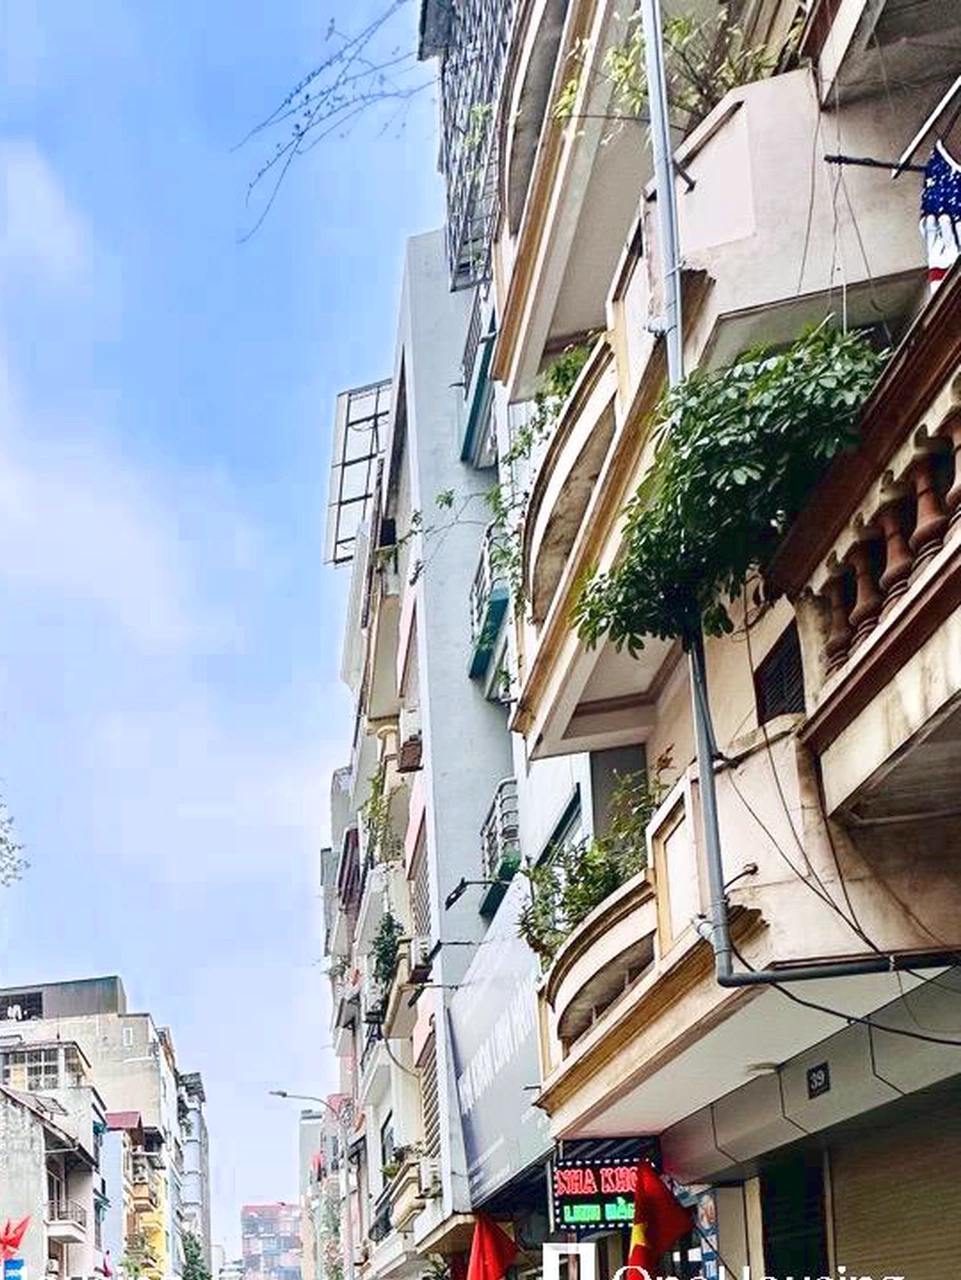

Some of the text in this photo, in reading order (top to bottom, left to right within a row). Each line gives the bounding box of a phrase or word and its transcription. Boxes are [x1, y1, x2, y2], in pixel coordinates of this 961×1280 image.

[810, 1070, 826, 1090] 39
[555, 1166, 639, 1195] NHA KHO
